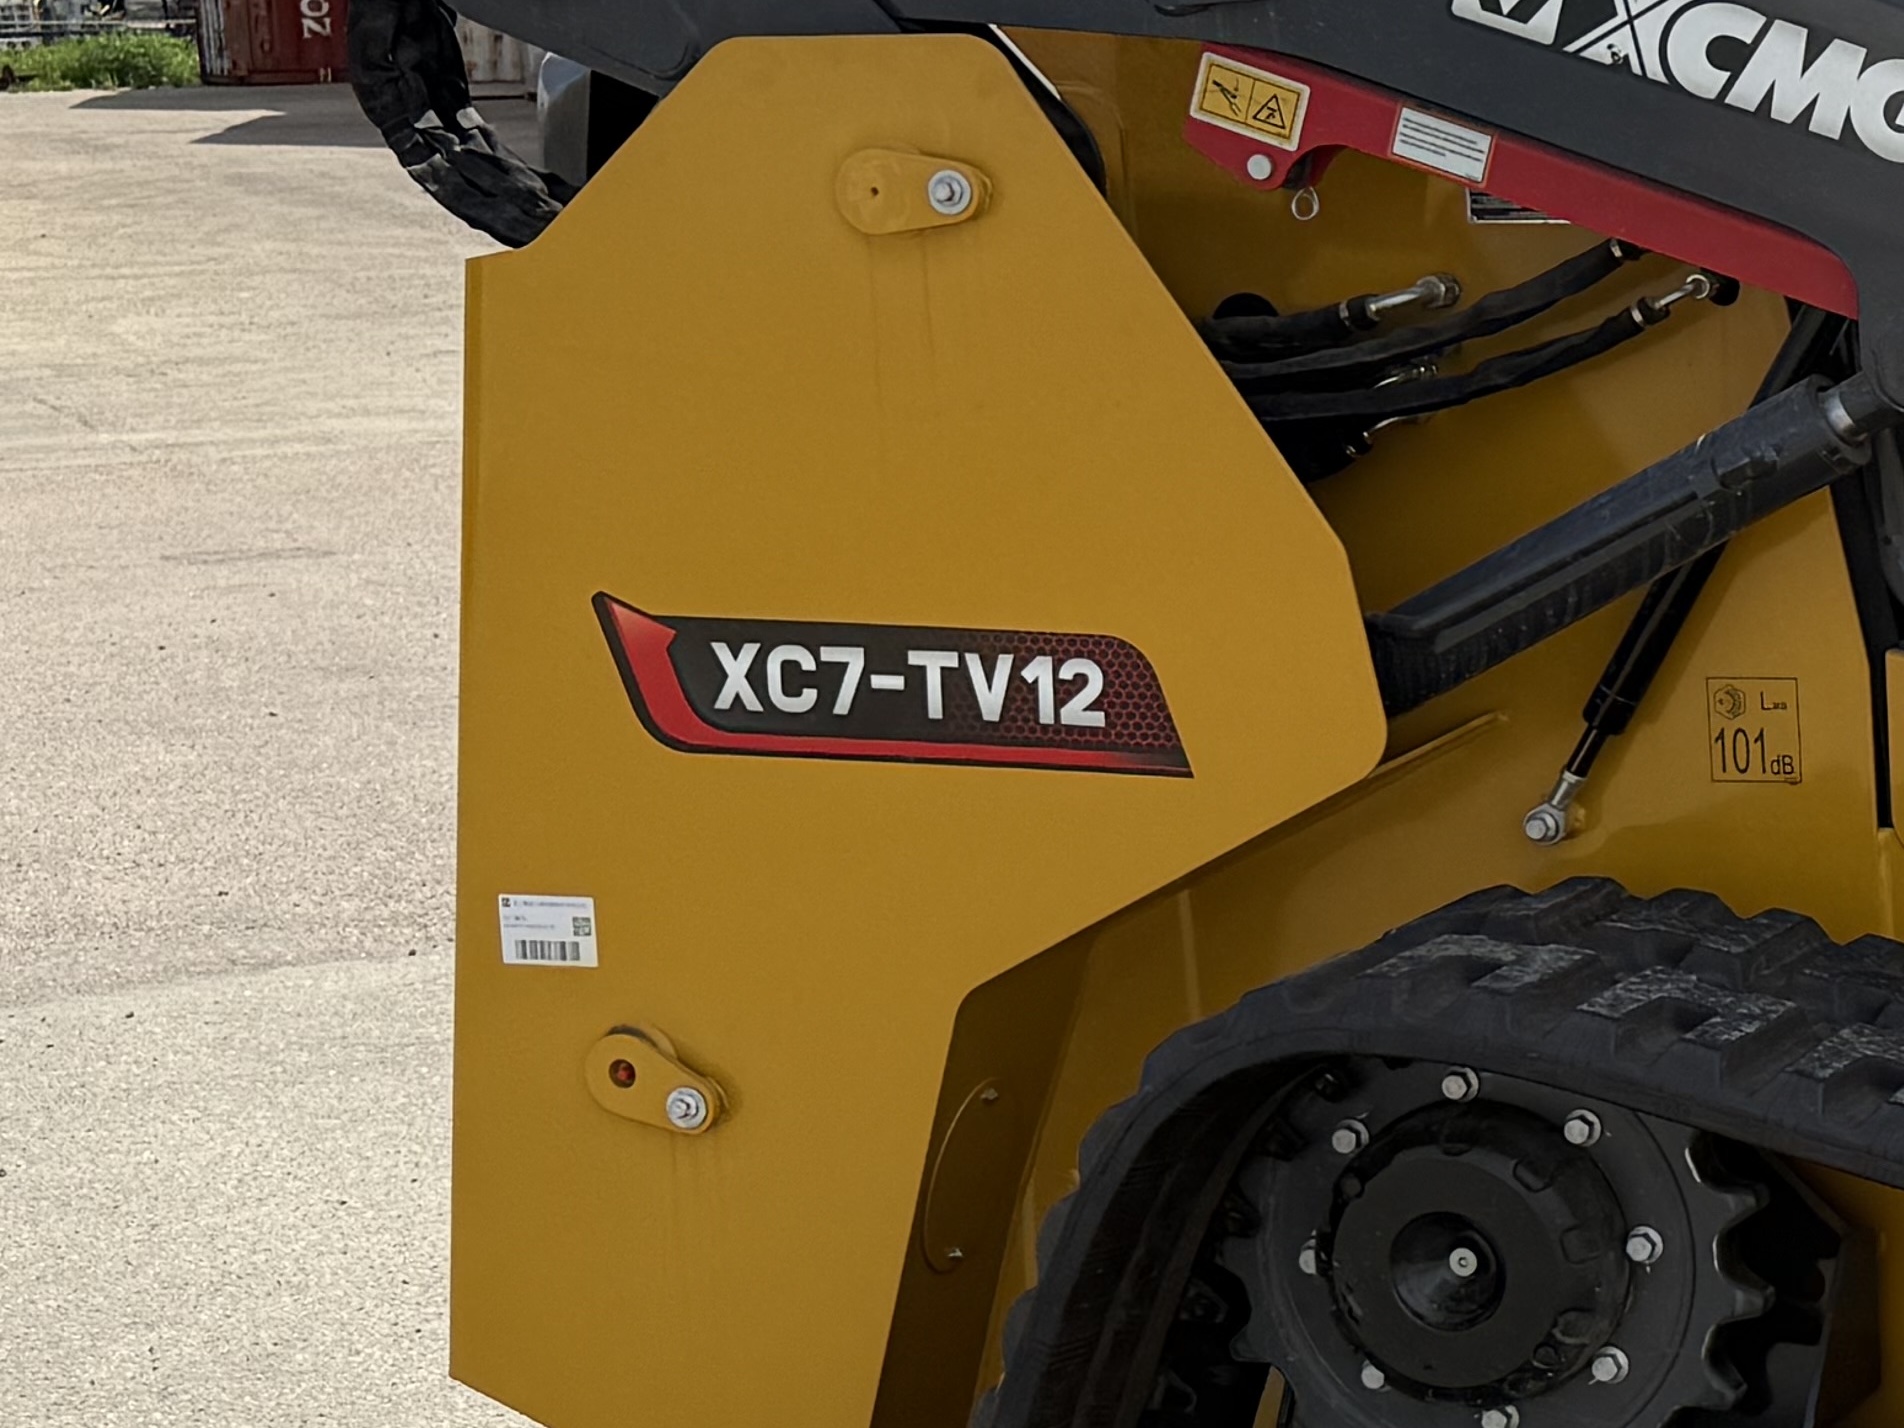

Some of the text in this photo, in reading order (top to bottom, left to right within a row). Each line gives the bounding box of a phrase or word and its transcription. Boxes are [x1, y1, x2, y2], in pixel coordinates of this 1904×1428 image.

[710, 641, 1106, 728] XC7-TV12
[1714, 727, 1795, 776] 101 dB
